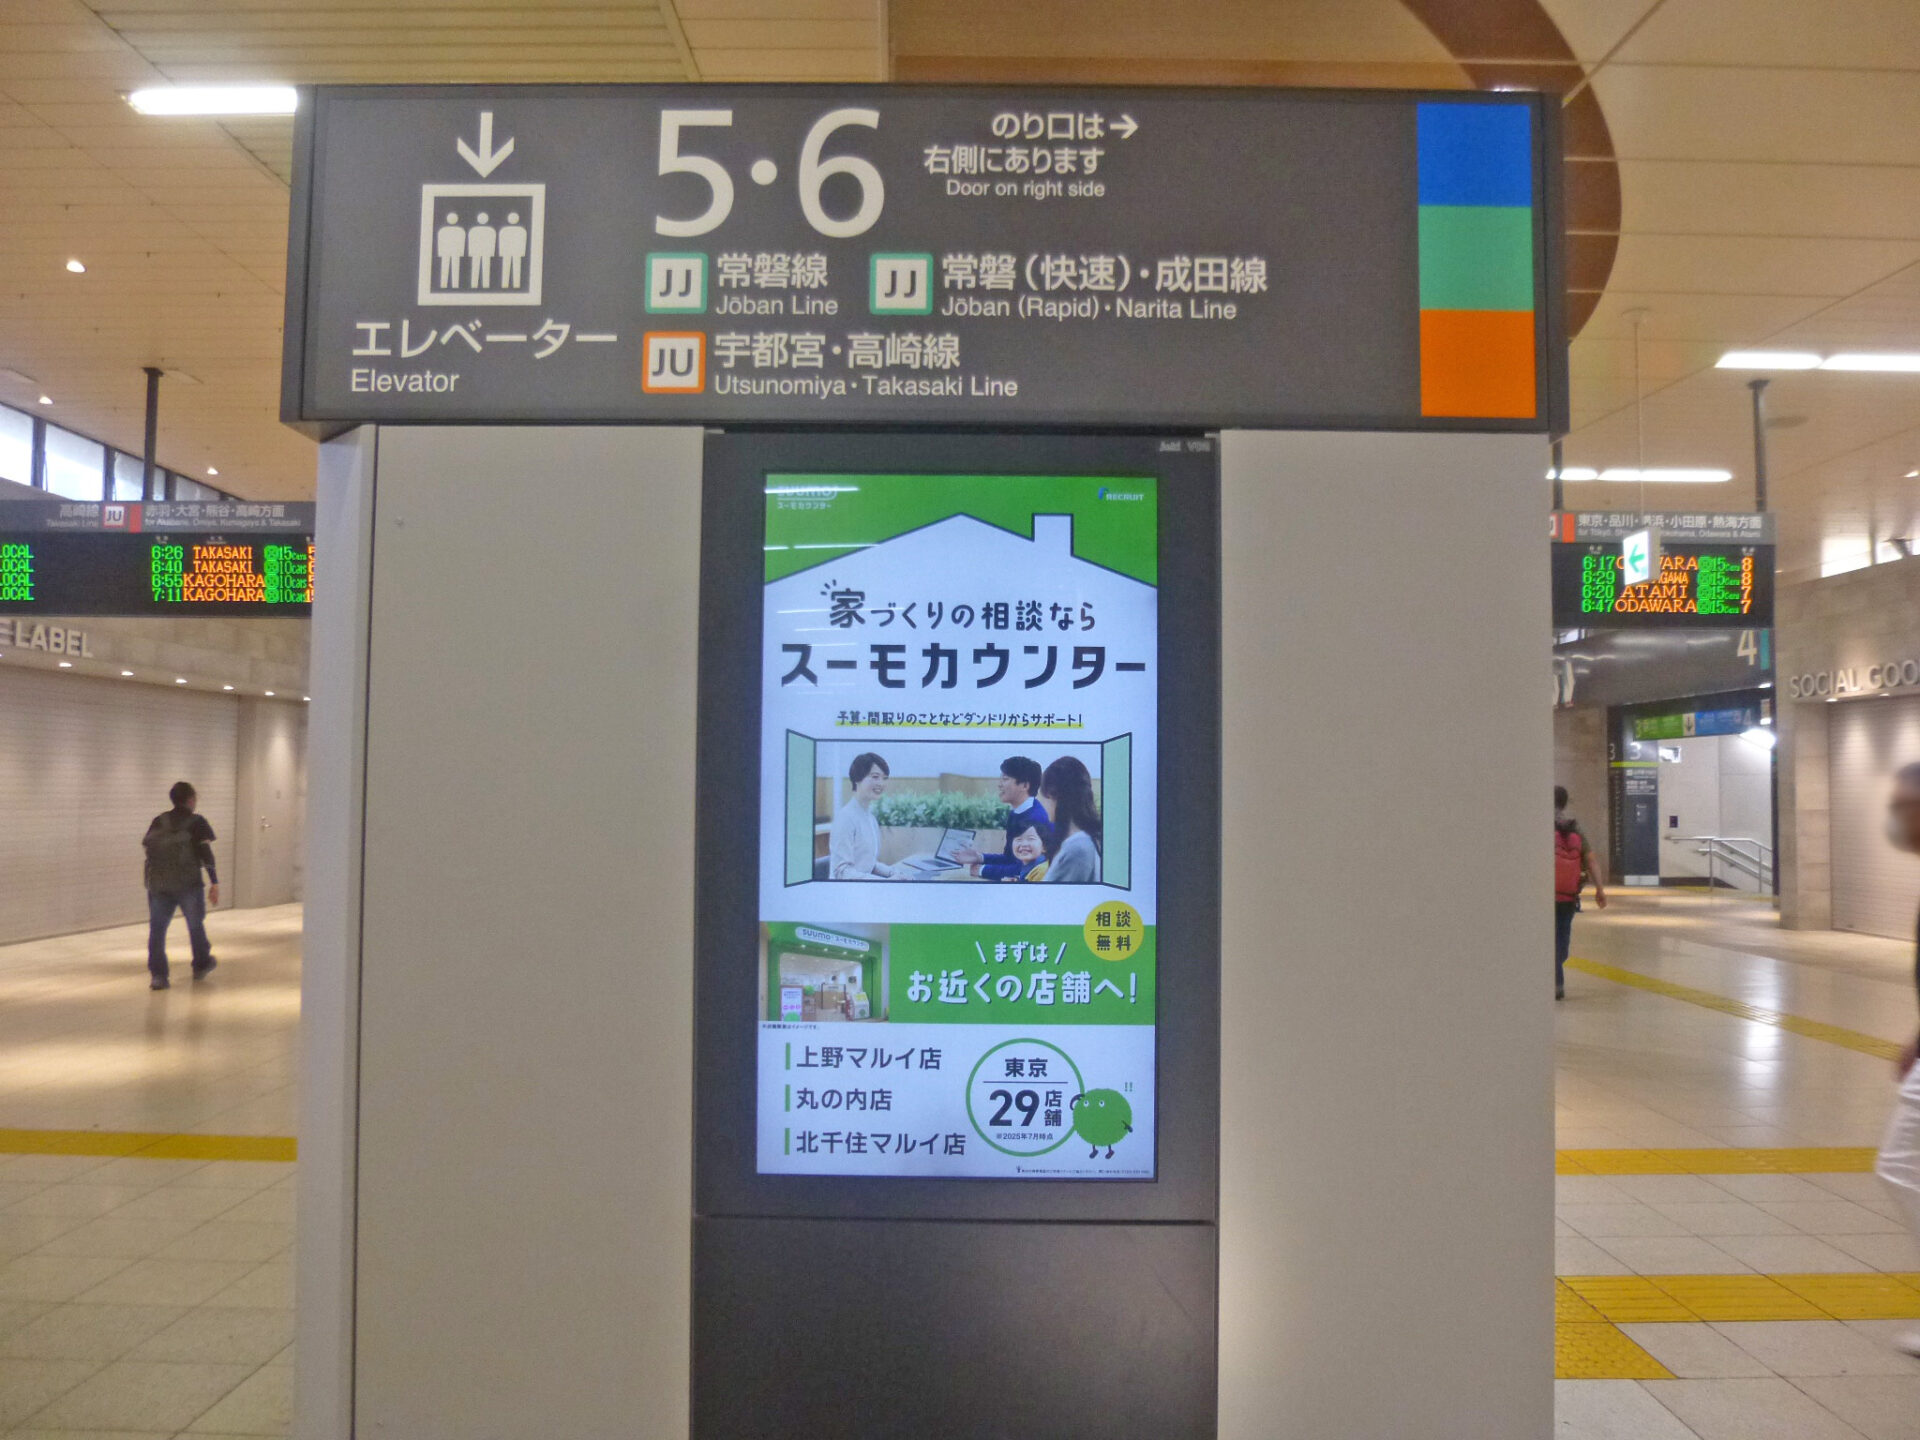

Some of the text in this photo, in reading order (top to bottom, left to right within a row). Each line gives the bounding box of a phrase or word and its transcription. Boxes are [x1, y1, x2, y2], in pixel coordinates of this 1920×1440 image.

[991, 112, 1104, 140] のり口は
[923, 144, 1105, 175] 右側にあります
[946, 178, 1105, 201] Door on right side
[717, 252, 828, 289] 常磐線
[659, 269, 692, 297] JJ
[884, 270, 917, 298] JJ
[792, 295, 839, 317] Line
[1190, 298, 1237, 320] Line
[352, 318, 618, 360] エレベーター
[713, 331, 961, 370] 宇都宮・高崎線
[652, 348, 694, 378] JU
[351, 368, 460, 393] Elevator
[971, 376, 1018, 397] Line
[107, 510, 122, 522] JU
[0, 545, 34, 558] OCAL
[152, 545, 183, 560] 6:26
[192, 546, 253, 560] TAKASAKI
[0, 559, 34, 572] OCAL
[152, 560, 182, 574] 6:40
[192, 560, 253, 574] TAKASAKI
[1582, 556, 1616, 570] 6:17
[1741, 556, 1753, 571] 8
[0, 573, 34, 586] OCAL
[152, 574, 183, 588] 6:55
[183, 574, 266, 588] KAGOHARA
[1582, 570, 1616, 584] 6:29
[1741, 571, 1753, 585] 8
[0, 587, 34, 600] OCAL
[152, 588, 182, 602] 7:11
[183, 588, 266, 602] KAGOHARA
[1582, 584, 1615, 599] 6:20
[1620, 584, 1688, 598] ATAMI
[1741, 585, 1752, 599] 7
[829, 587, 1096, 632] 家づくりの相談なら
[1581, 599, 1615, 613] 6:47
[1614, 599, 1698, 613] ODAWARA
[1741, 599, 1752, 614] 7
[15, 620, 94, 658] LABEL
[1737, 629, 1758, 666] 4
[781, 642, 1146, 690] スーモカウンター
[1790, 660, 1920, 698] SOCIAL GOO
[1629, 741, 1642, 761] 3
[1094, 909, 1132, 928] 相談
[994, 941, 1048, 964] まずは
[1095, 934, 1132, 952] 無料
[906, 969, 1138, 1005] お近くの店舗へ!
[796, 1045, 942, 1071] 上野マルイ店
[1004, 1057, 1048, 1078] 東京
[796, 1087, 892, 1111] 丸の内店
[988, 1089, 1040, 1127] 29
[1043, 1089, 1063, 1127] 店舗
[796, 1130, 966, 1156] 北千住マルイ店
